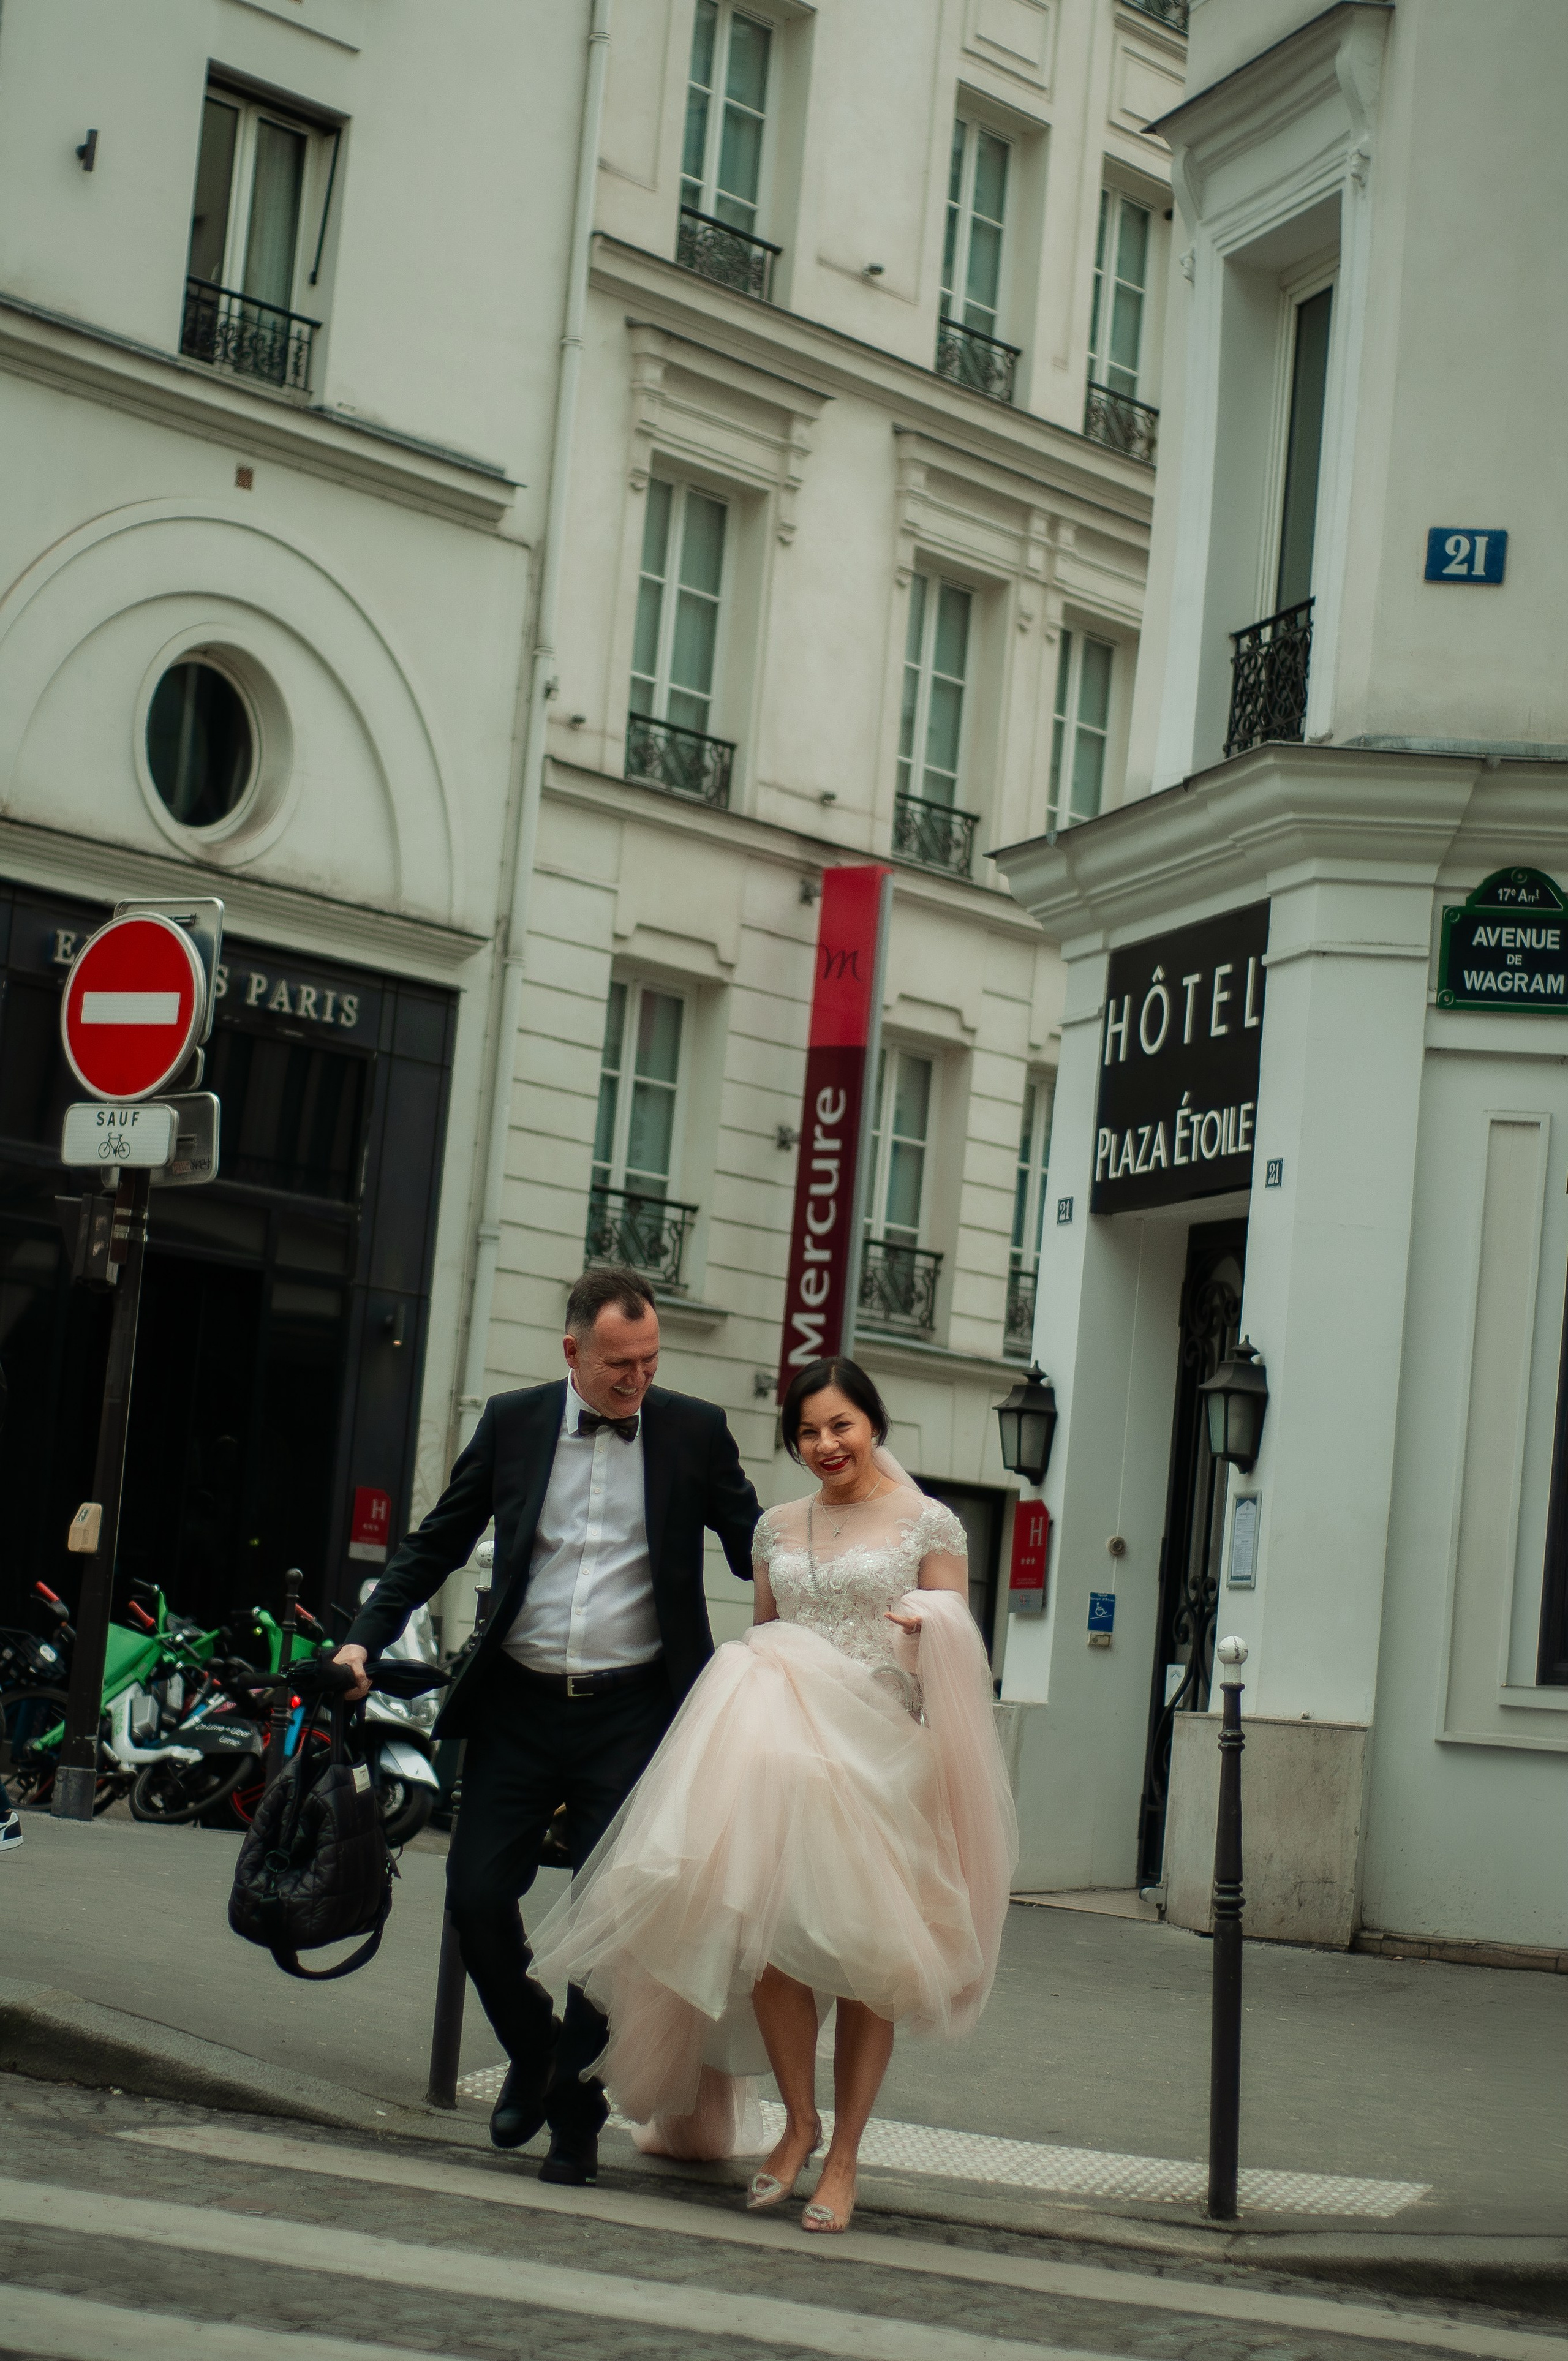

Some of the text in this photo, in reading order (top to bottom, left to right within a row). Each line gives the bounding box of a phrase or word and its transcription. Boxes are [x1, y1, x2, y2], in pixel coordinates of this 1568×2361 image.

[1442, 535, 1488, 576] 21
[1472, 926, 1561, 949] AVENUE
[1507, 954, 1523, 965] DE
[1463, 970, 1565, 995] WAGRAM
[245, 971, 360, 1028] PARIS
[1104, 957, 1259, 1066] HÔTEL
[97, 1111, 140, 1126] SAUF
[1268, 1162, 1279, 1184] 21
[1059, 1200, 1069, 1221] 21
[788, 1086, 846, 1366] Mercure
[371, 1499, 387, 1520] H
[1029, 1516, 1044, 1546] H
